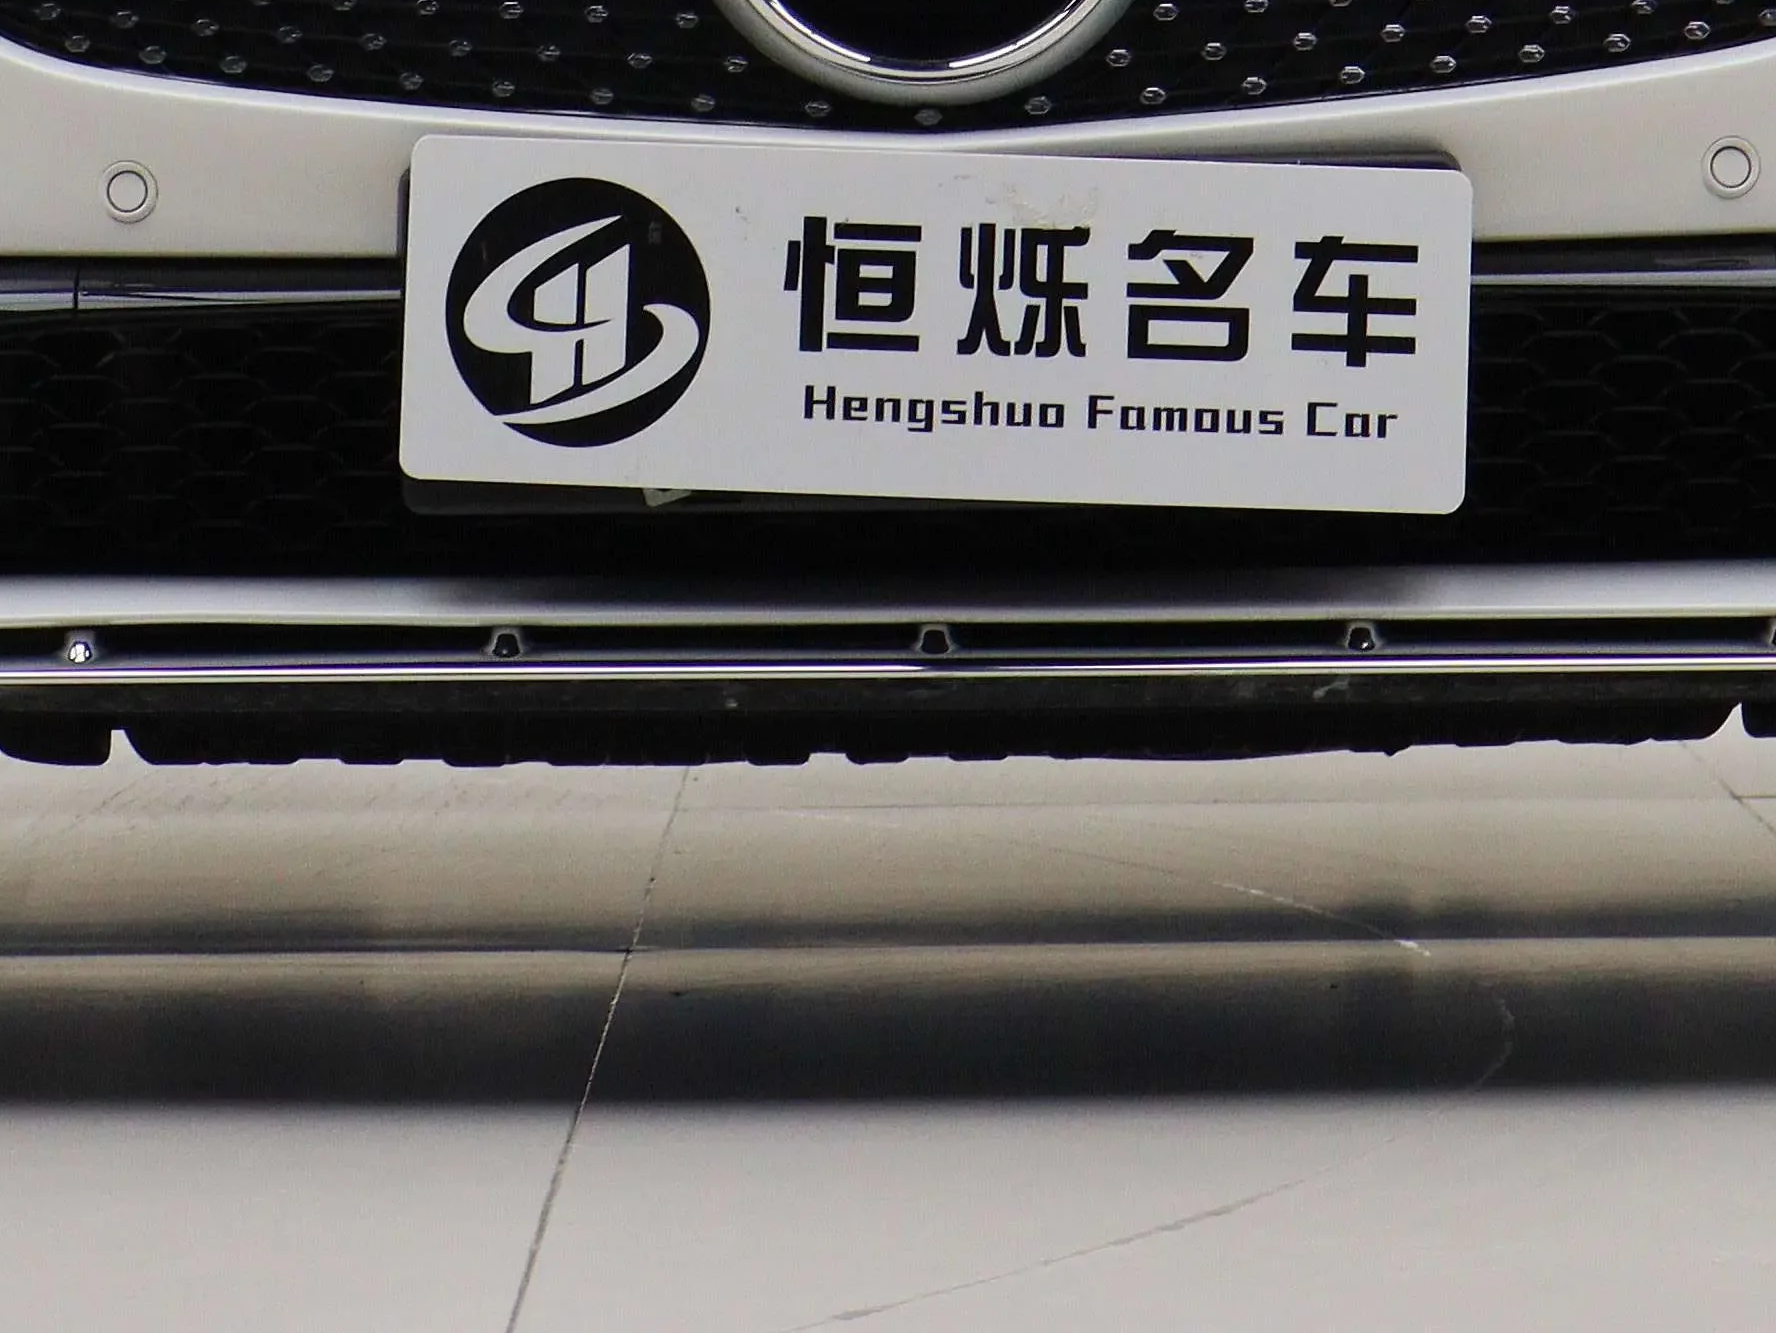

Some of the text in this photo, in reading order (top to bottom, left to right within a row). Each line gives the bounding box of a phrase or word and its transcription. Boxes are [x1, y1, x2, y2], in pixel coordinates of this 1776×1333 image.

[784, 216, 1419, 368] 恒烁名车
[803, 384, 1398, 439] Hengshuo Famous Car
